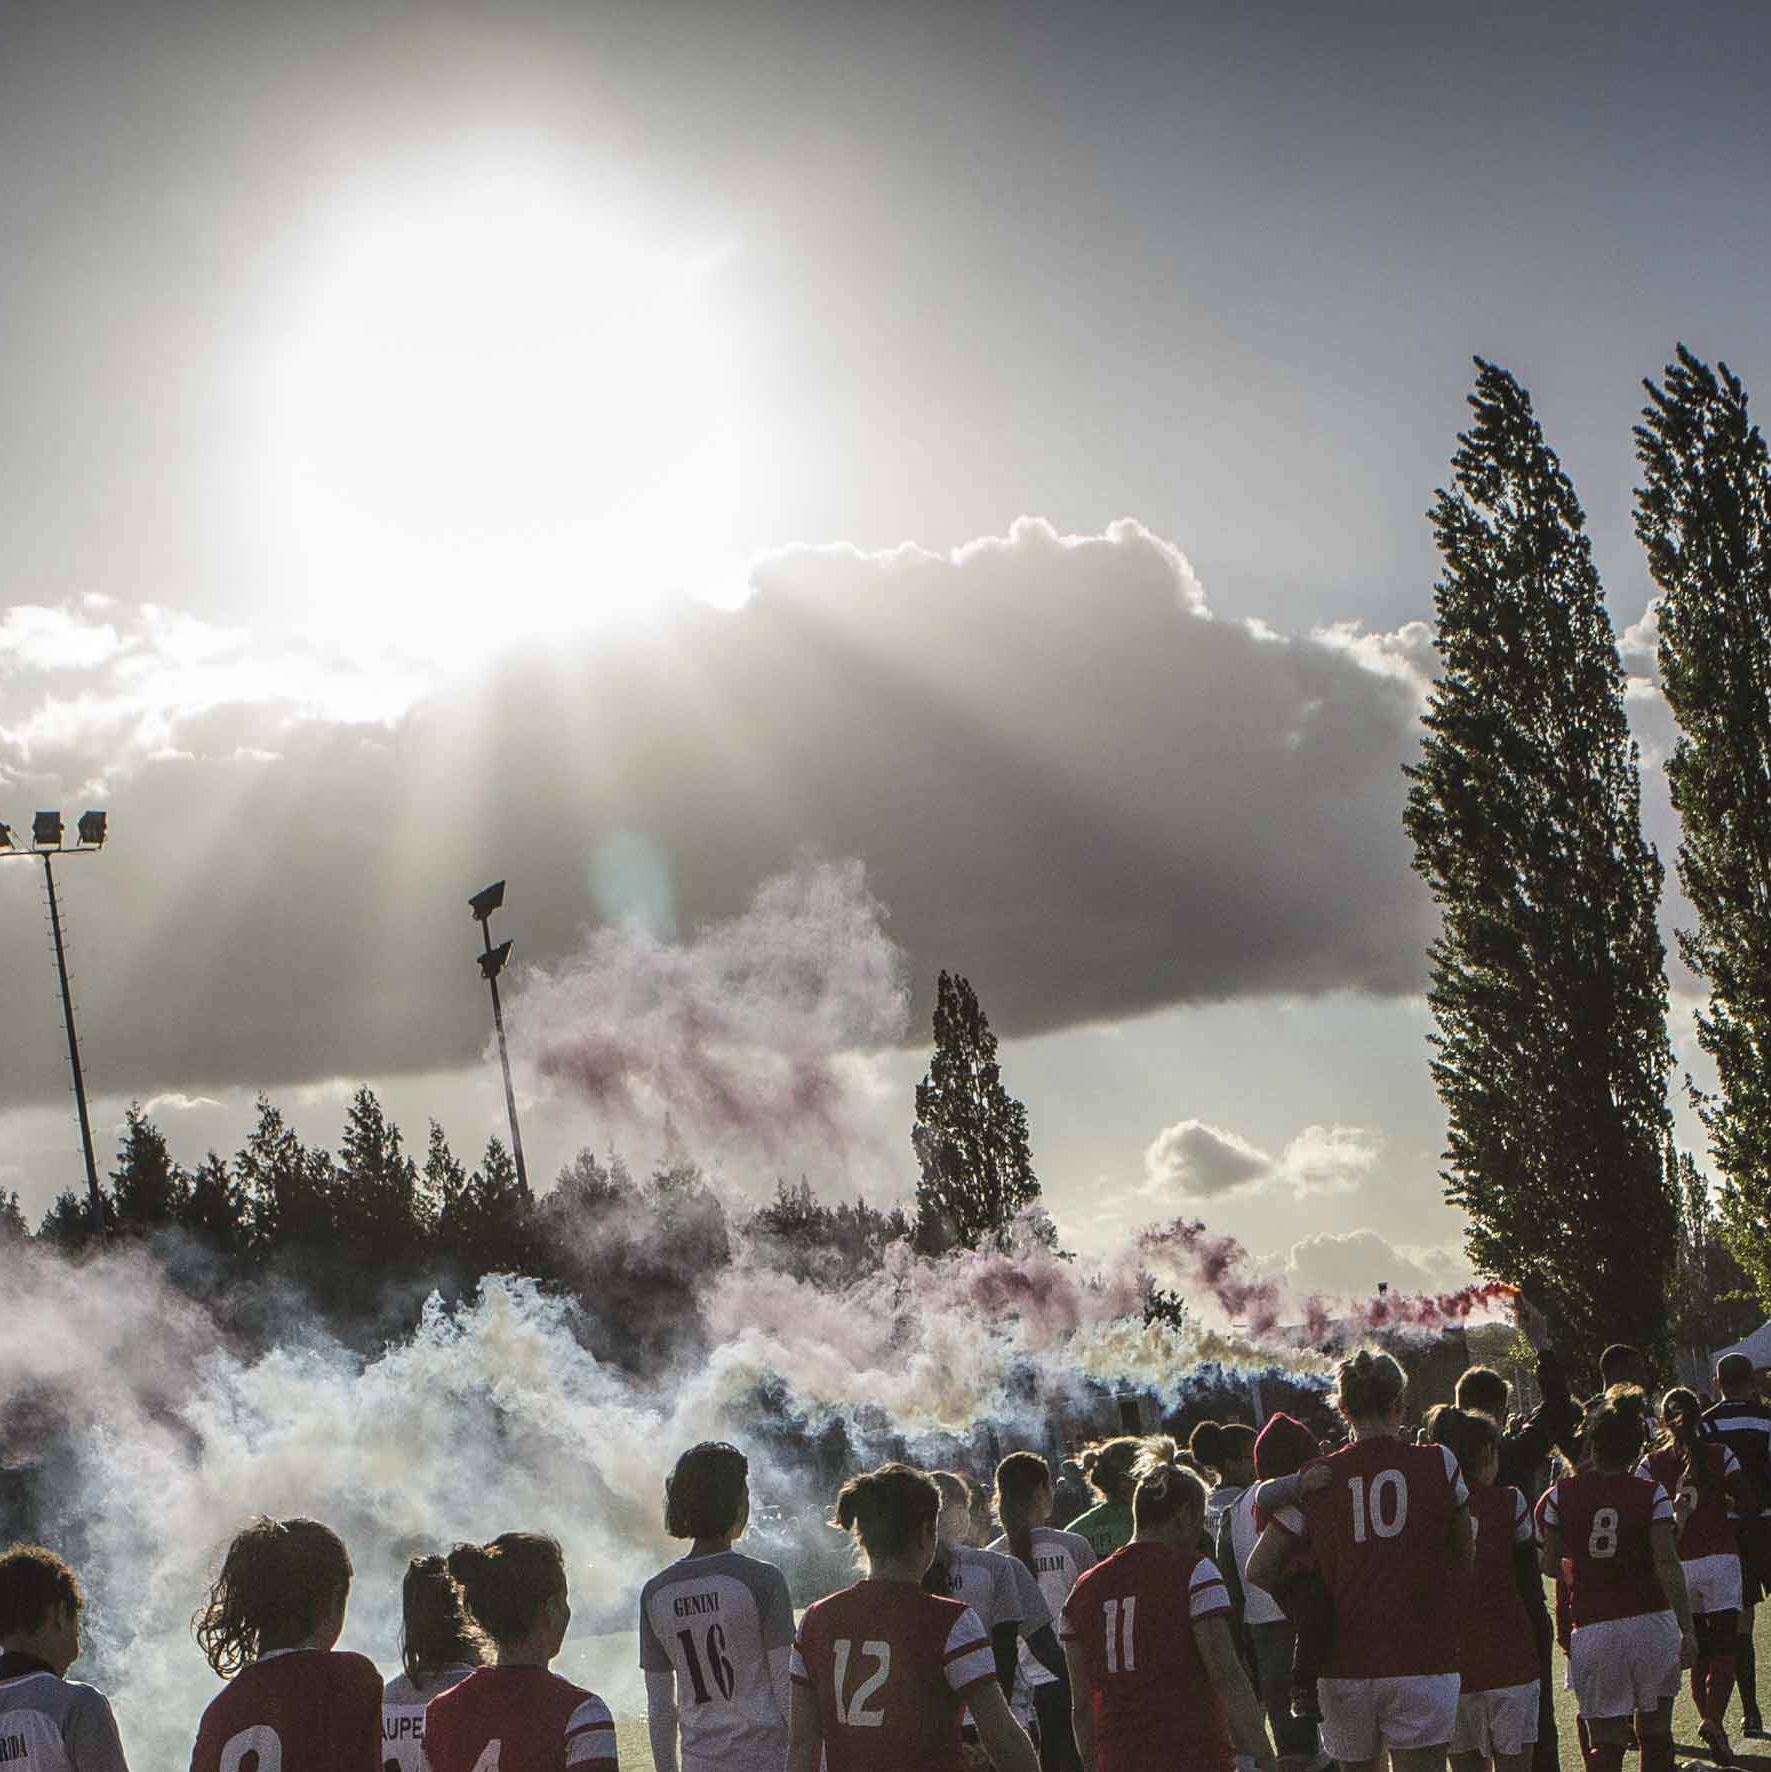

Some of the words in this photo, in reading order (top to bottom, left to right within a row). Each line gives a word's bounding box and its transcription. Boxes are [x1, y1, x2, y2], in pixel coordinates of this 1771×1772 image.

[1348, 1469, 1408, 1543] 10
[1589, 1507, 1619, 1559] 8
[674, 1592, 719, 1618] GENINI
[1103, 1596, 1136, 1674] 11
[676, 1623, 735, 1704] 16
[833, 1639, 891, 1726] 12
